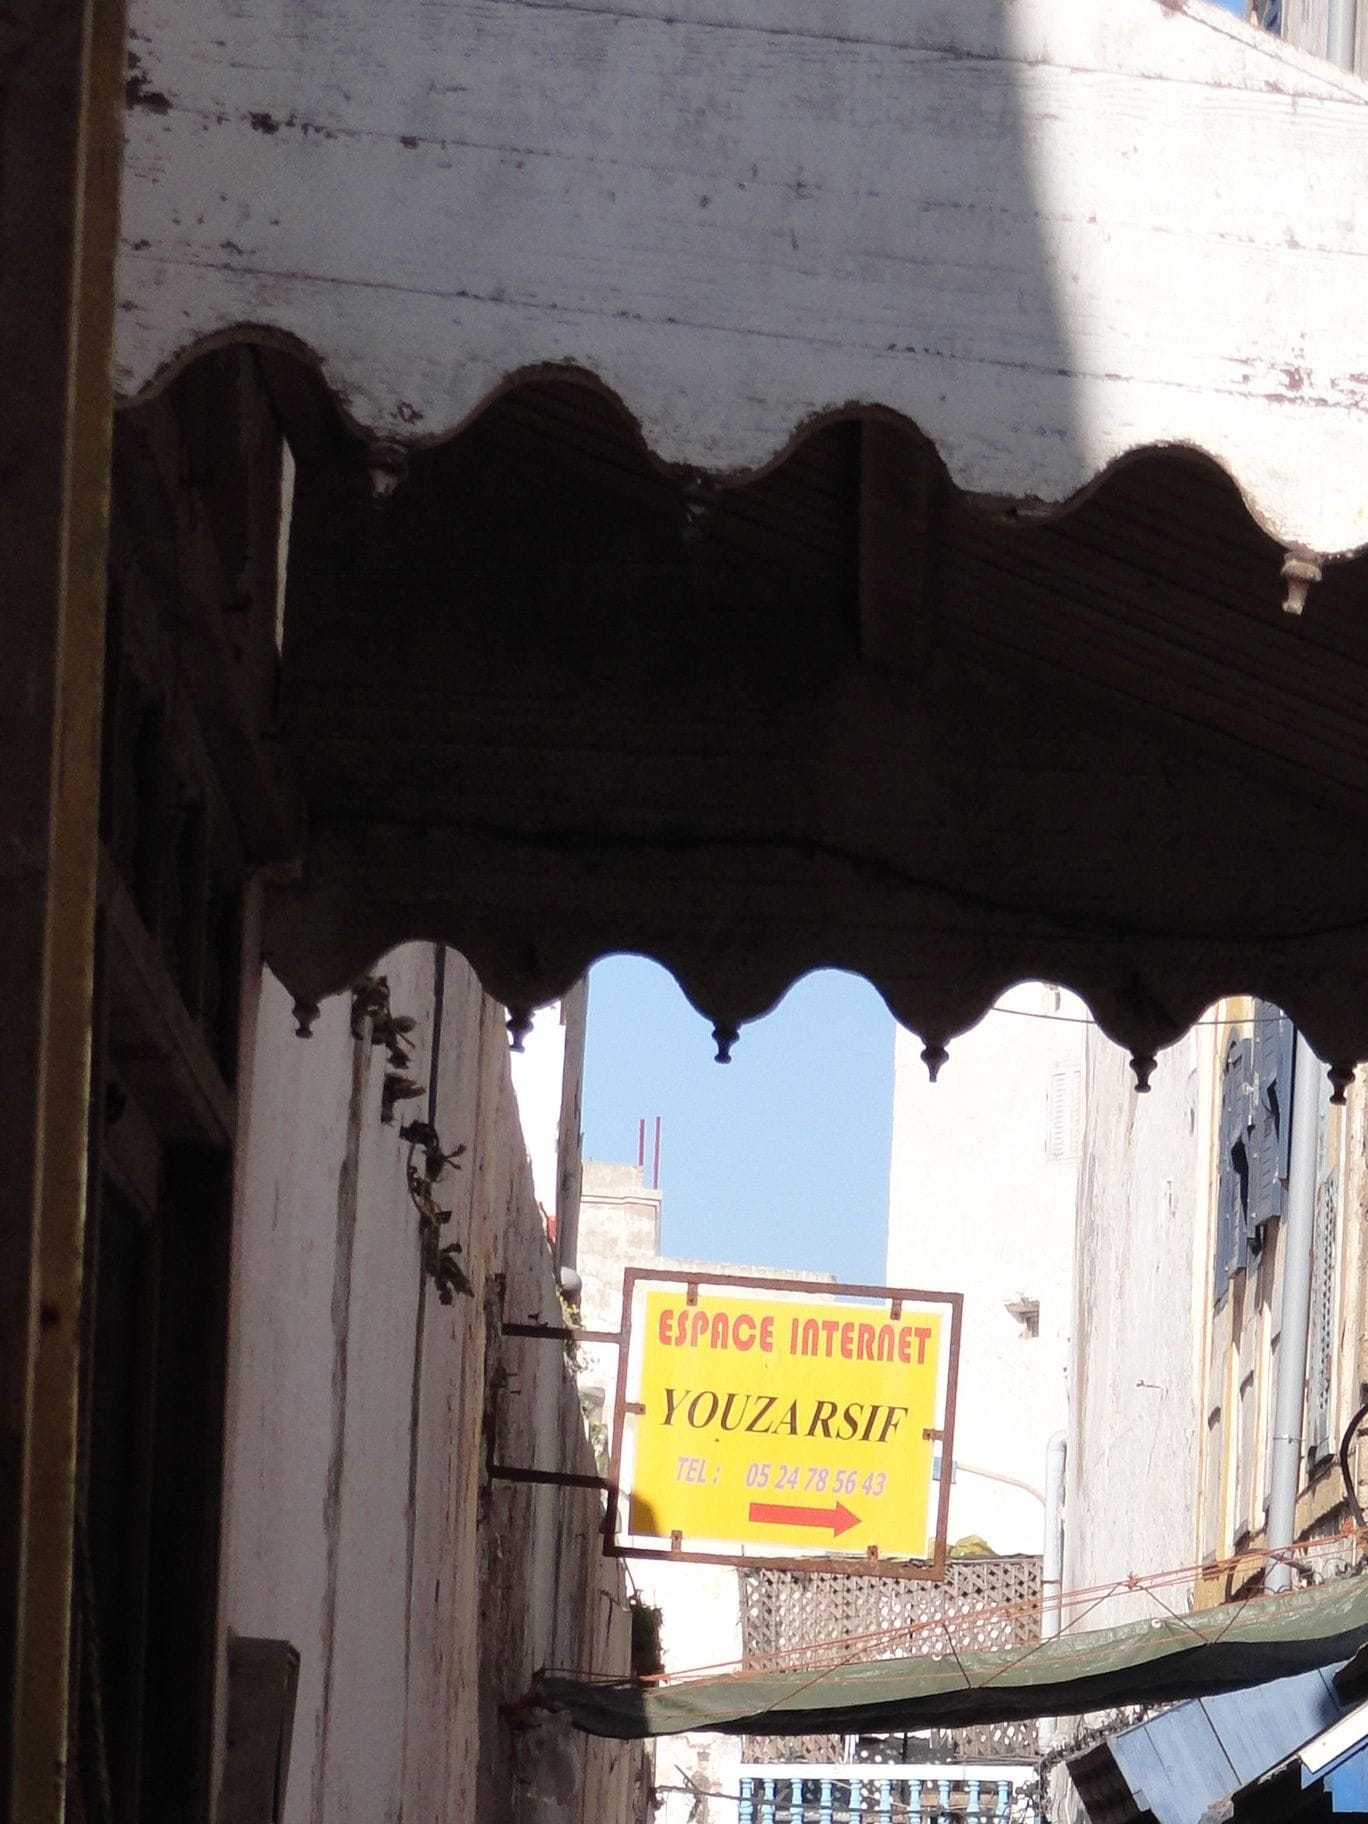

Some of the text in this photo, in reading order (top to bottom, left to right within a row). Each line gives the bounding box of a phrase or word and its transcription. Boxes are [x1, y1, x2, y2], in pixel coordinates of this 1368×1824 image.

[658, 1309, 932, 1365] ESPACE INTERNET
[660, 1387, 909, 1443] YOUZARSIF
[745, 1462, 770, 1488] 05
[774, 1465, 800, 1490] 24
[803, 1467, 828, 1492] 78
[832, 1469, 858, 1495] 56
[862, 1471, 887, 1497] 43
